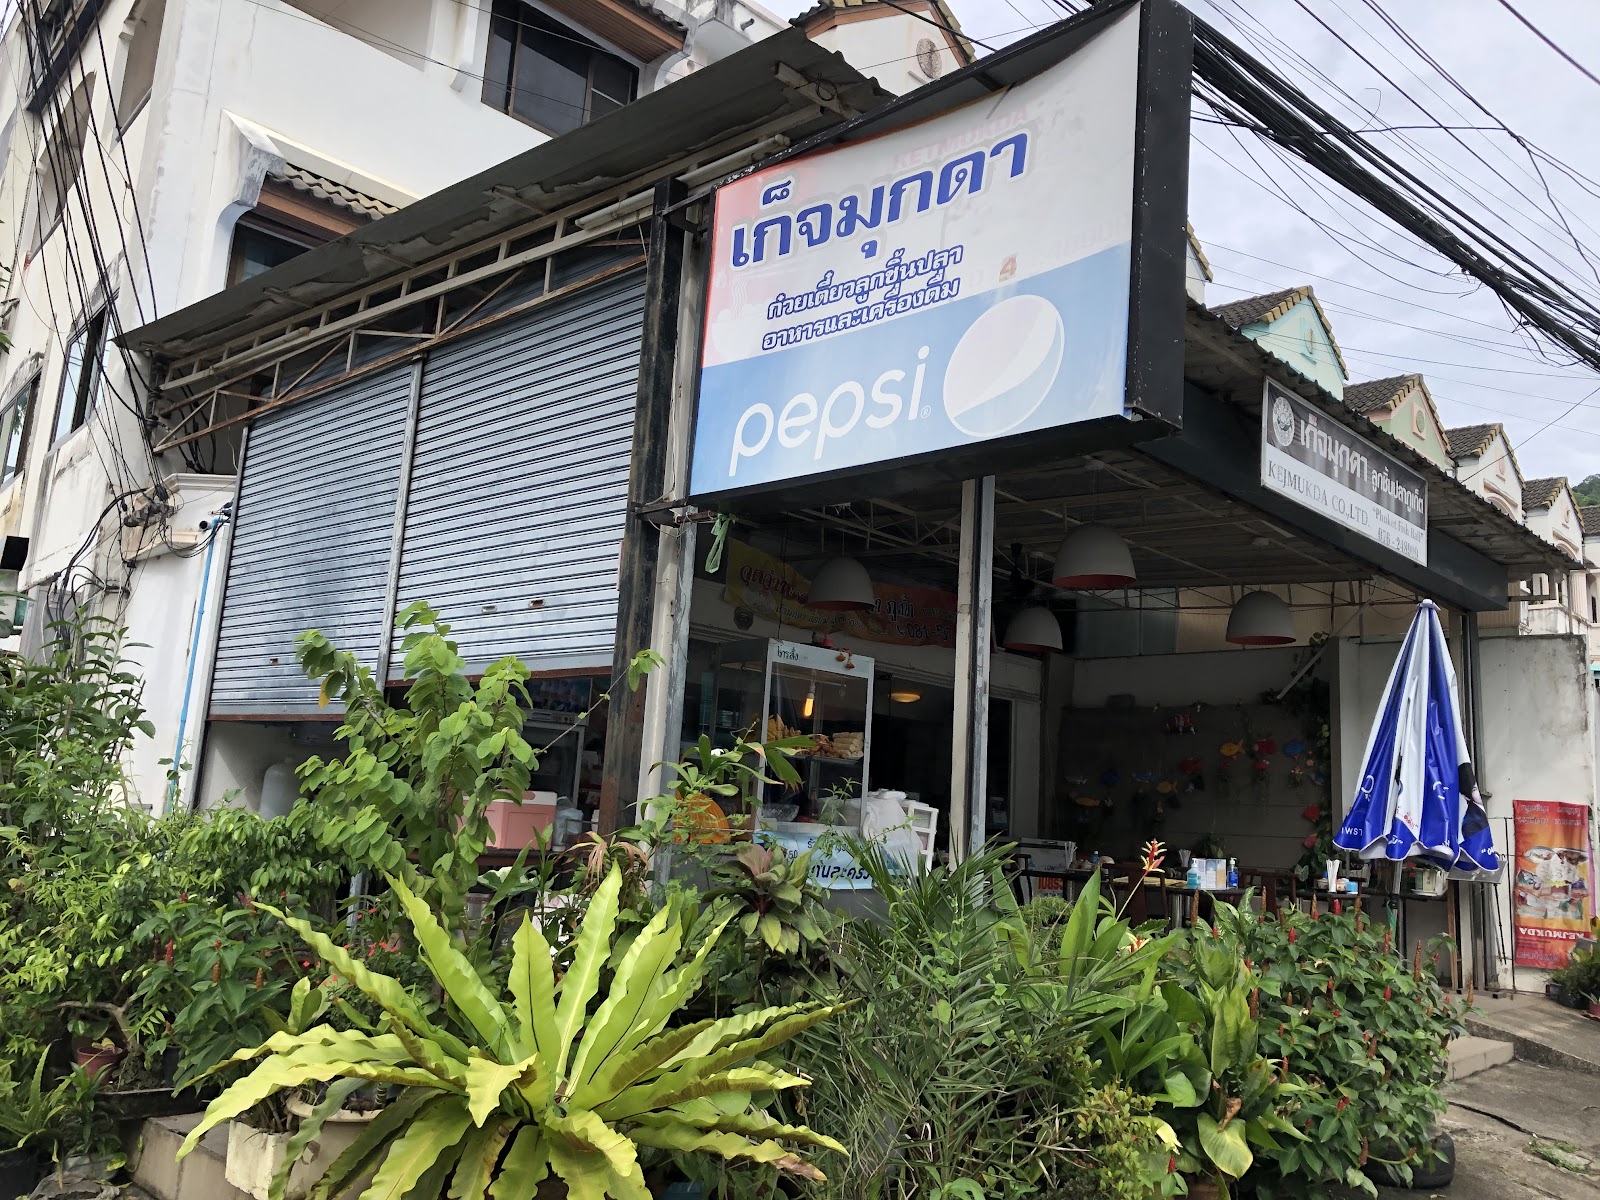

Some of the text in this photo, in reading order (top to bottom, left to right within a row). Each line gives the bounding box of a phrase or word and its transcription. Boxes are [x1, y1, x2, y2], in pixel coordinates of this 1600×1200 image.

[732, 132, 1029, 268] เก็จมุกดา
[761, 271, 961, 351] อาหารและเครื่องดื่ม
[728, 345, 930, 476] pepsi
[1268, 460, 1328, 506] KEJMUKDA
